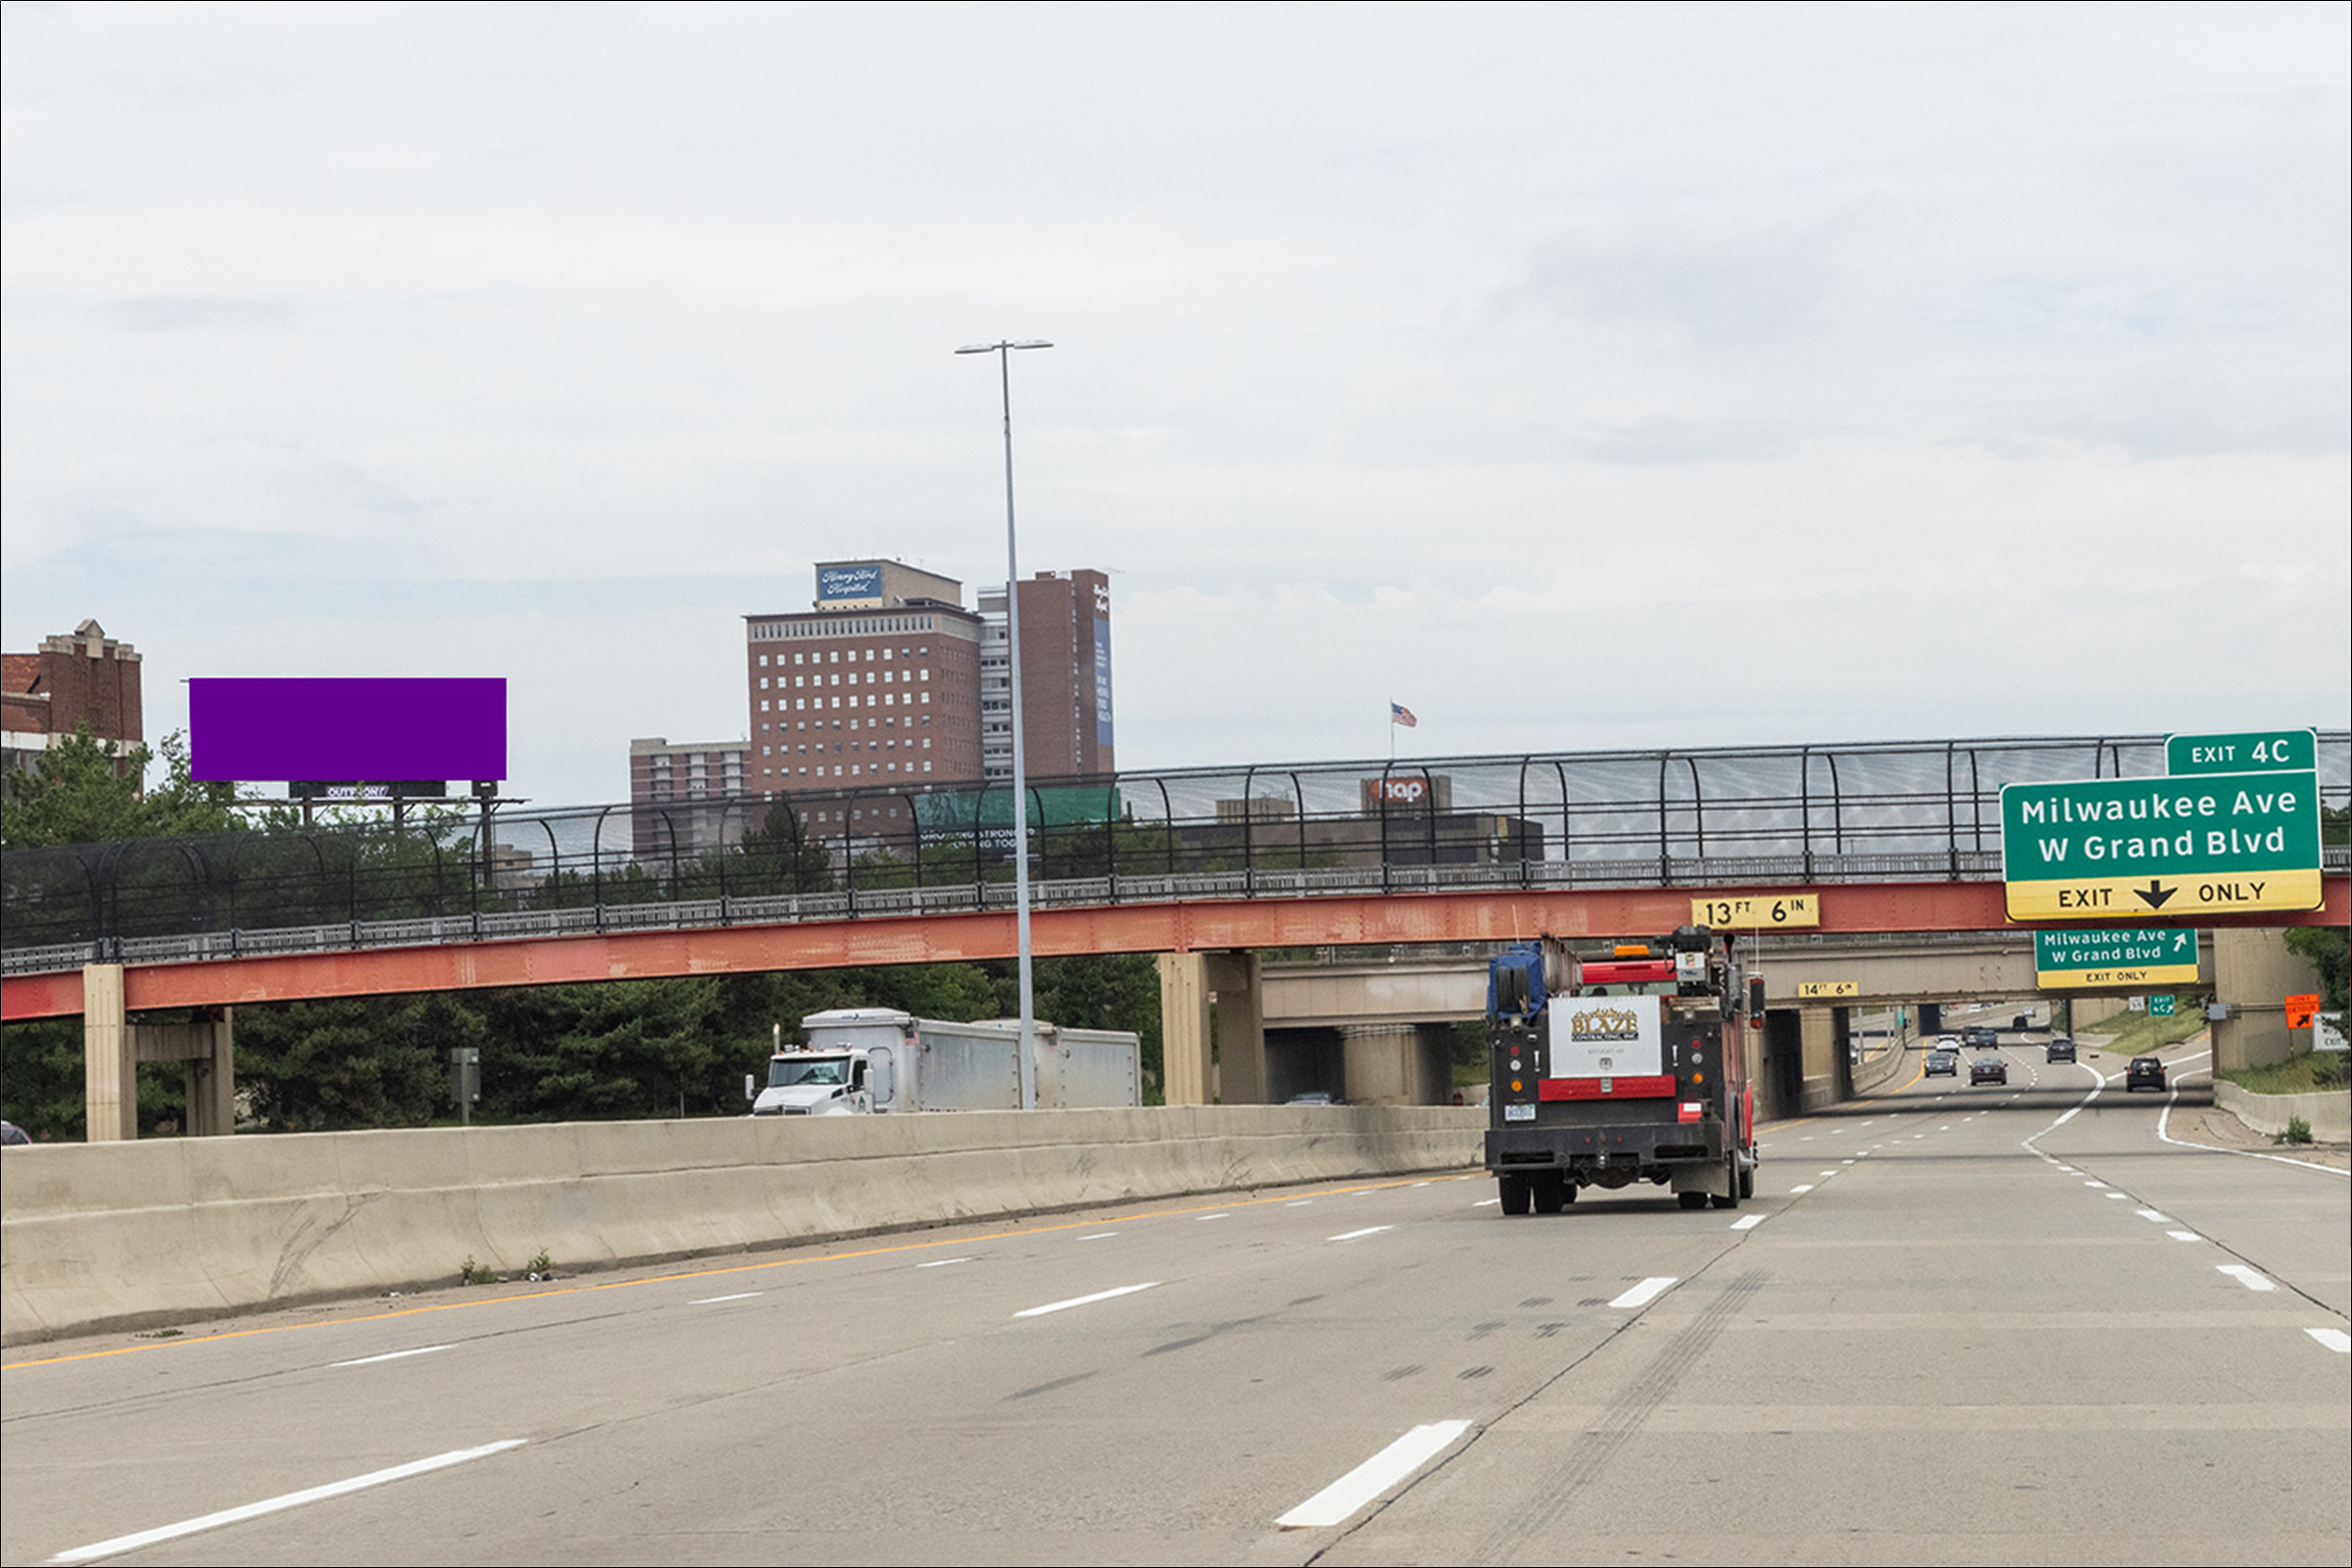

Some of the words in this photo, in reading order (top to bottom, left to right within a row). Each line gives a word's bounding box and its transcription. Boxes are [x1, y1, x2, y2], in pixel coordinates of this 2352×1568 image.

[2192, 746, 2236, 762] EXIT
[2252, 739, 2290, 763] 4C
[2022, 794, 2216, 823] Milwaukee
[2232, 791, 2296, 815] Ave
[2038, 837, 2069, 861] W
[2084, 830, 2193, 859] Grand
[2207, 826, 2284, 855] Blvd
[2059, 888, 2113, 907] EXIT
[2199, 882, 2266, 903] ONLY
[1706, 903, 1732, 924] 13
[1736, 902, 1750, 913] FT
[1772, 901, 1787, 922] 6
[1791, 900, 1804, 911] IN
[2044, 932, 2131, 946] Milwaukee
[2136, 930, 2166, 942] Ave
[2052, 951, 2066, 962] W
[2072, 948, 2121, 962] Grand
[2126, 946, 2161, 959] Blvd
[2086, 972, 2111, 982] EXIT
[2117, 971, 2147, 980] ONLY
[1804, 984, 1818, 995] 14
[1836, 984, 1844, 995] 6
[1572, 1018, 1639, 1032] BLAZE
